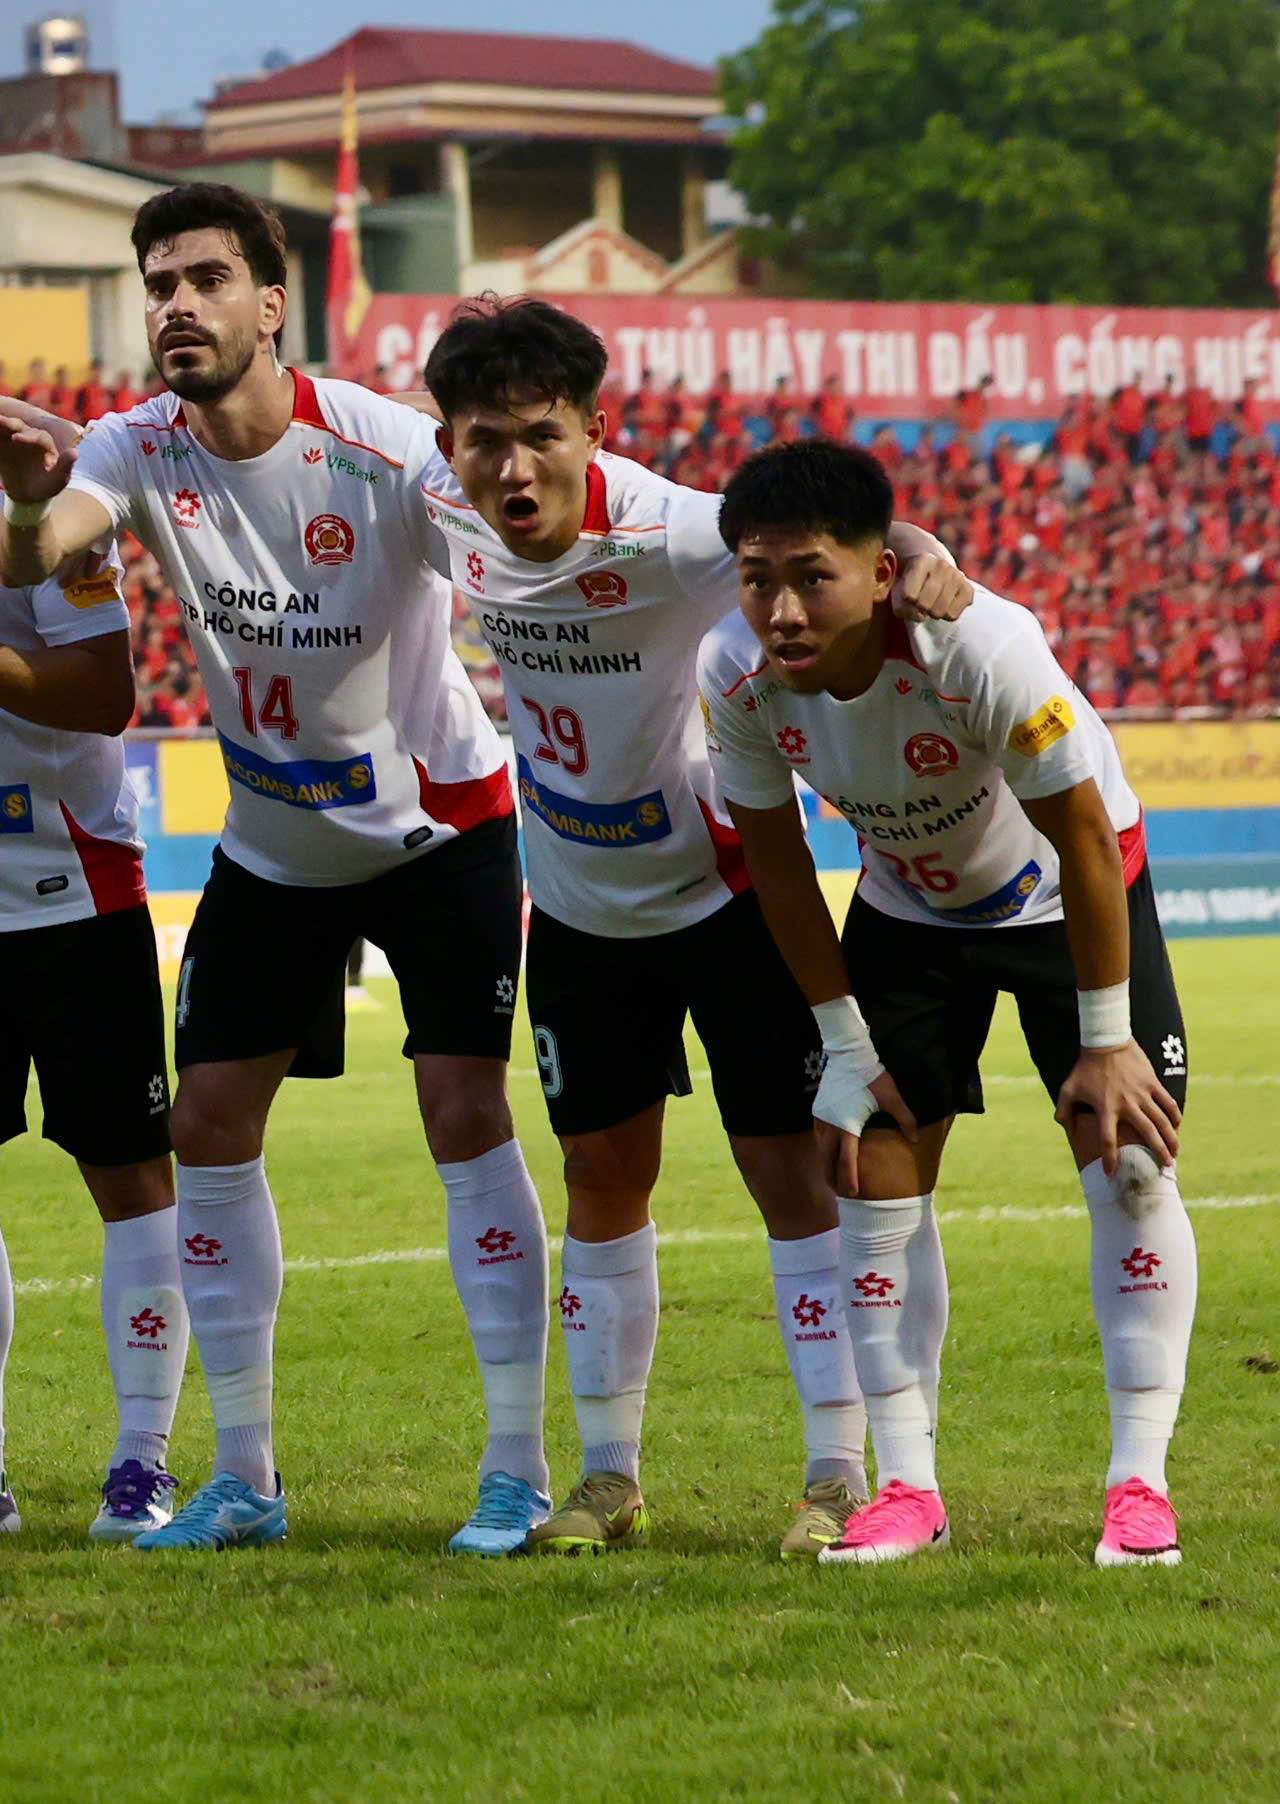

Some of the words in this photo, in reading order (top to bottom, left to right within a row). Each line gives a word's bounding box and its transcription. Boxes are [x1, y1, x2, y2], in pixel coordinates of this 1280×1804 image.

[836, 328, 917, 395] THI
[327, 454, 379, 484] VPBank
[598, 542, 646, 557] PBank
[204, 581, 277, 612] CÔNG
[284, 593, 320, 614] AN
[238, 620, 285, 647] CHÍ
[292, 625, 362, 649] MINH
[483, 611, 548, 642] CÔNG
[556, 624, 591, 644] AN
[521, 649, 565, 674] CHÍ
[569, 651, 643, 674] MINH
[232, 666, 300, 741] 14
[833, 795, 897, 819] ÔNG
[905, 794, 943, 817] AN
[871, 824, 919, 841] CHÍ
[924, 786, 991, 837] MINH
[534, 1024, 564, 1098] 9
